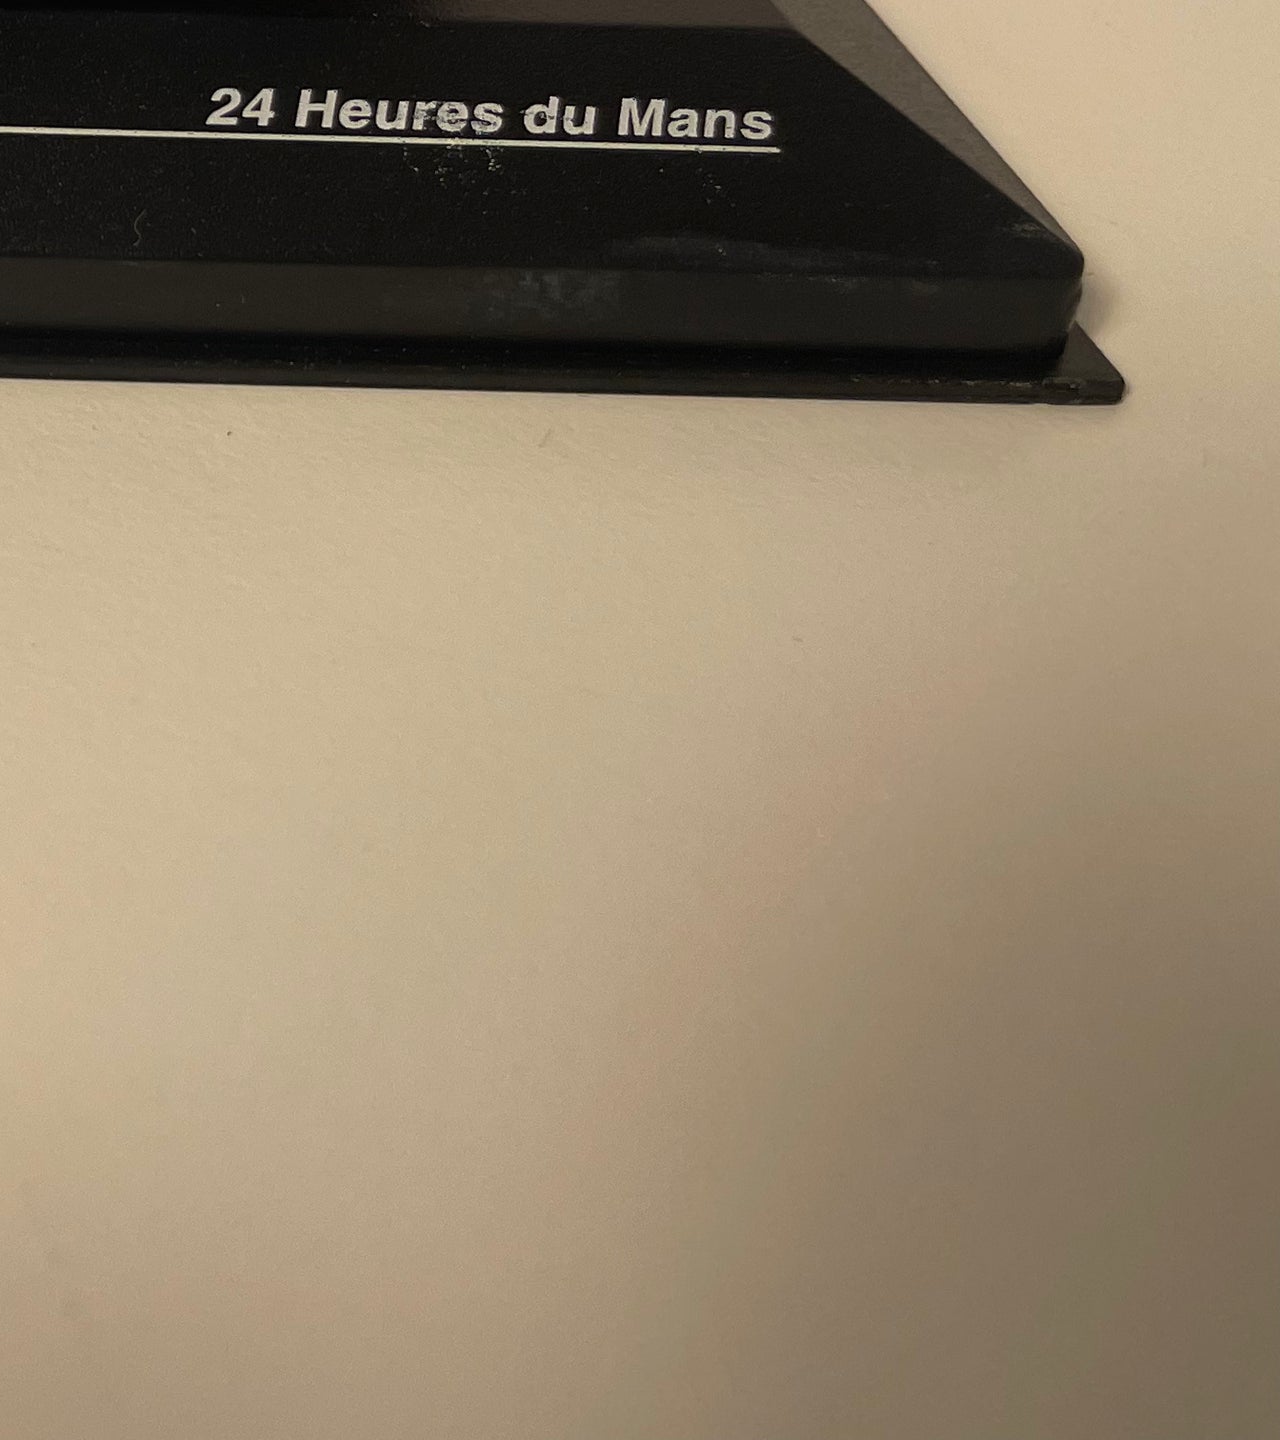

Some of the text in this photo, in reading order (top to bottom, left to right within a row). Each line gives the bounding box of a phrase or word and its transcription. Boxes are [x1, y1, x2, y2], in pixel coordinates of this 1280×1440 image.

[205, 88, 774, 141] 24 Heures du Mans
